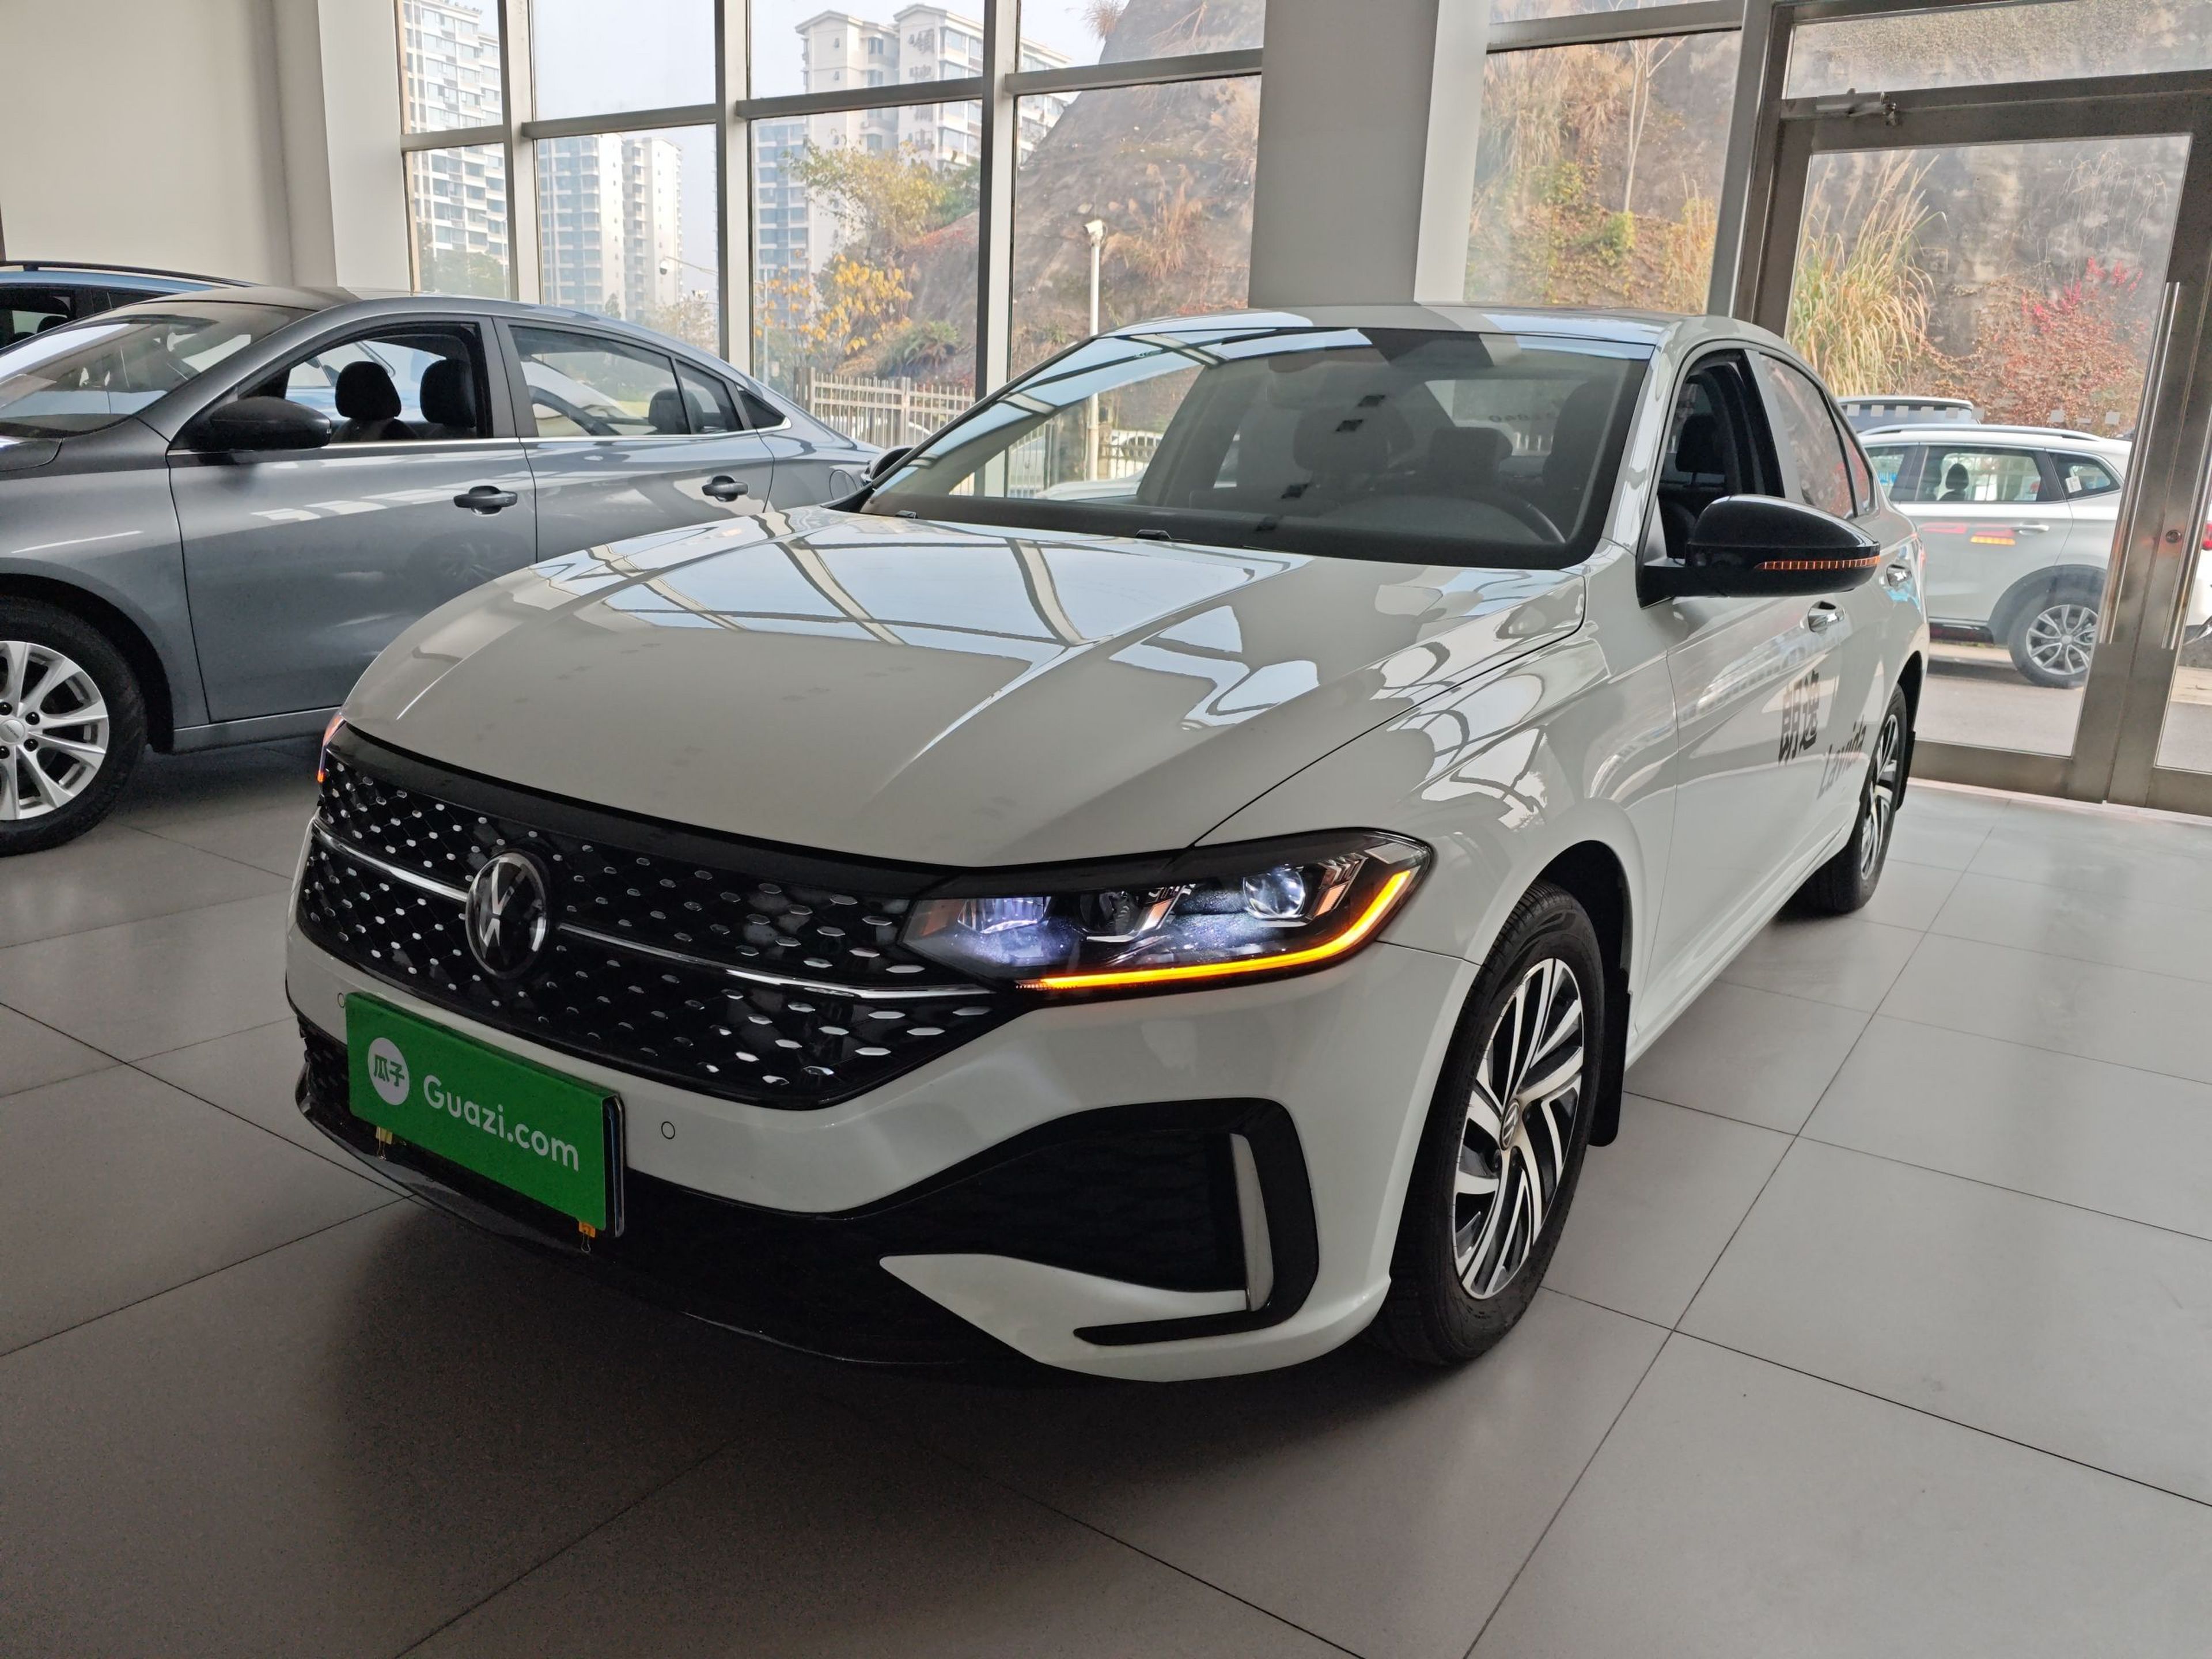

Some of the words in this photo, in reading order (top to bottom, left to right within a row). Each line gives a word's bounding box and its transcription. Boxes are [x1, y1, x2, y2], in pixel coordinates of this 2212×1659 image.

[1778, 668, 1820, 767] 朗逸
[373, 1053, 405, 1088] 瓜子
[423, 1074, 579, 1172] Guazi.com
